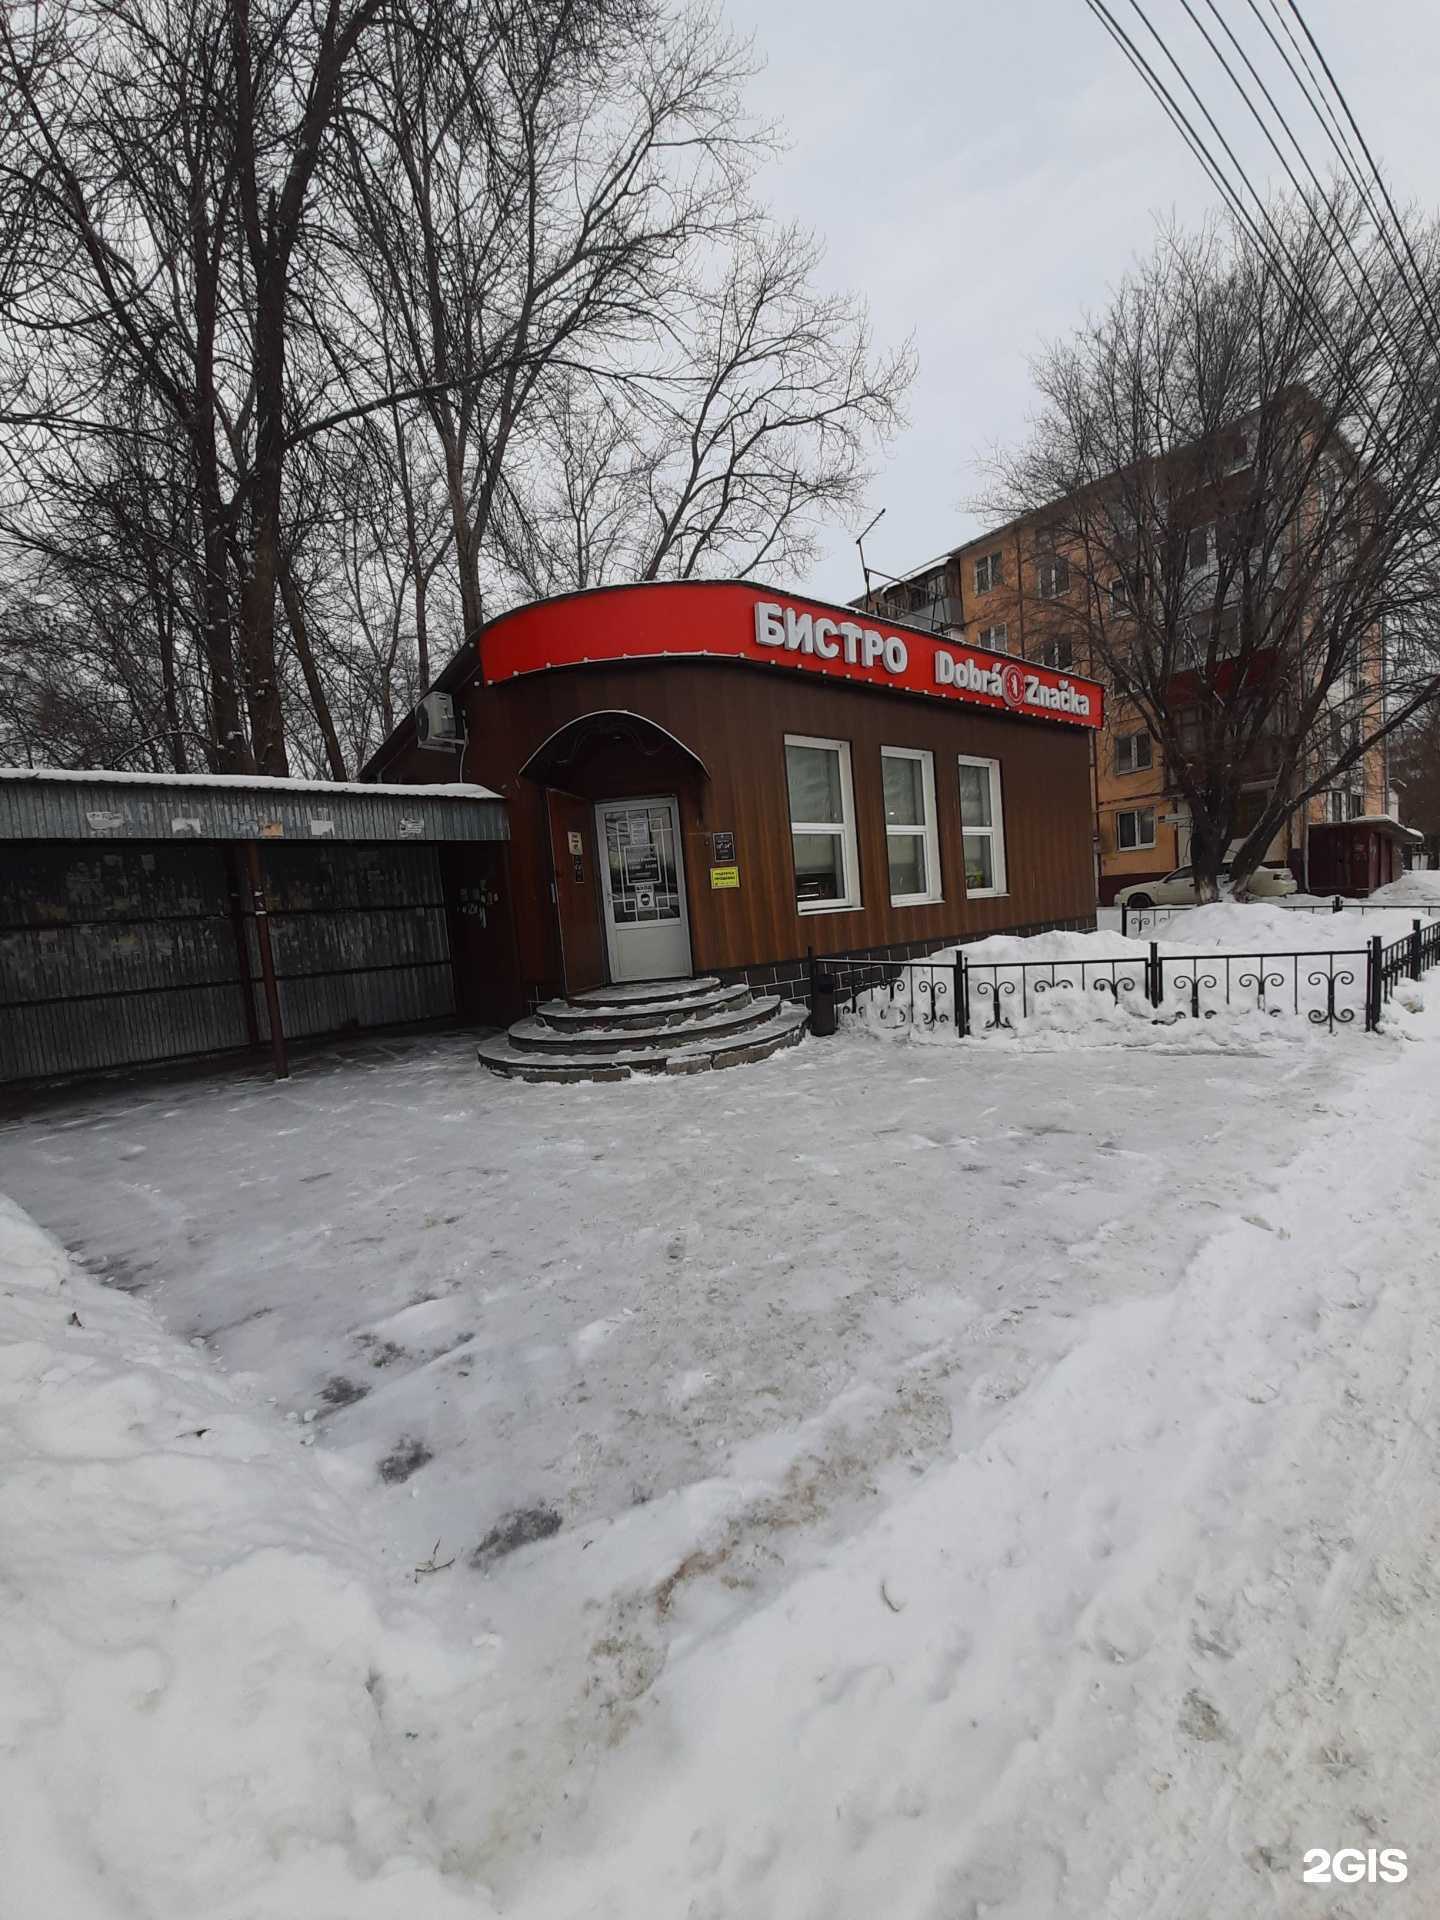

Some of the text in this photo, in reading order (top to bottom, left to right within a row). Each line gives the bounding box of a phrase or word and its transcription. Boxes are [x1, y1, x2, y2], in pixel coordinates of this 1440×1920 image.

[754, 601, 908, 674] БИСТРО
[934, 650, 1091, 716] Dobrá Značka
